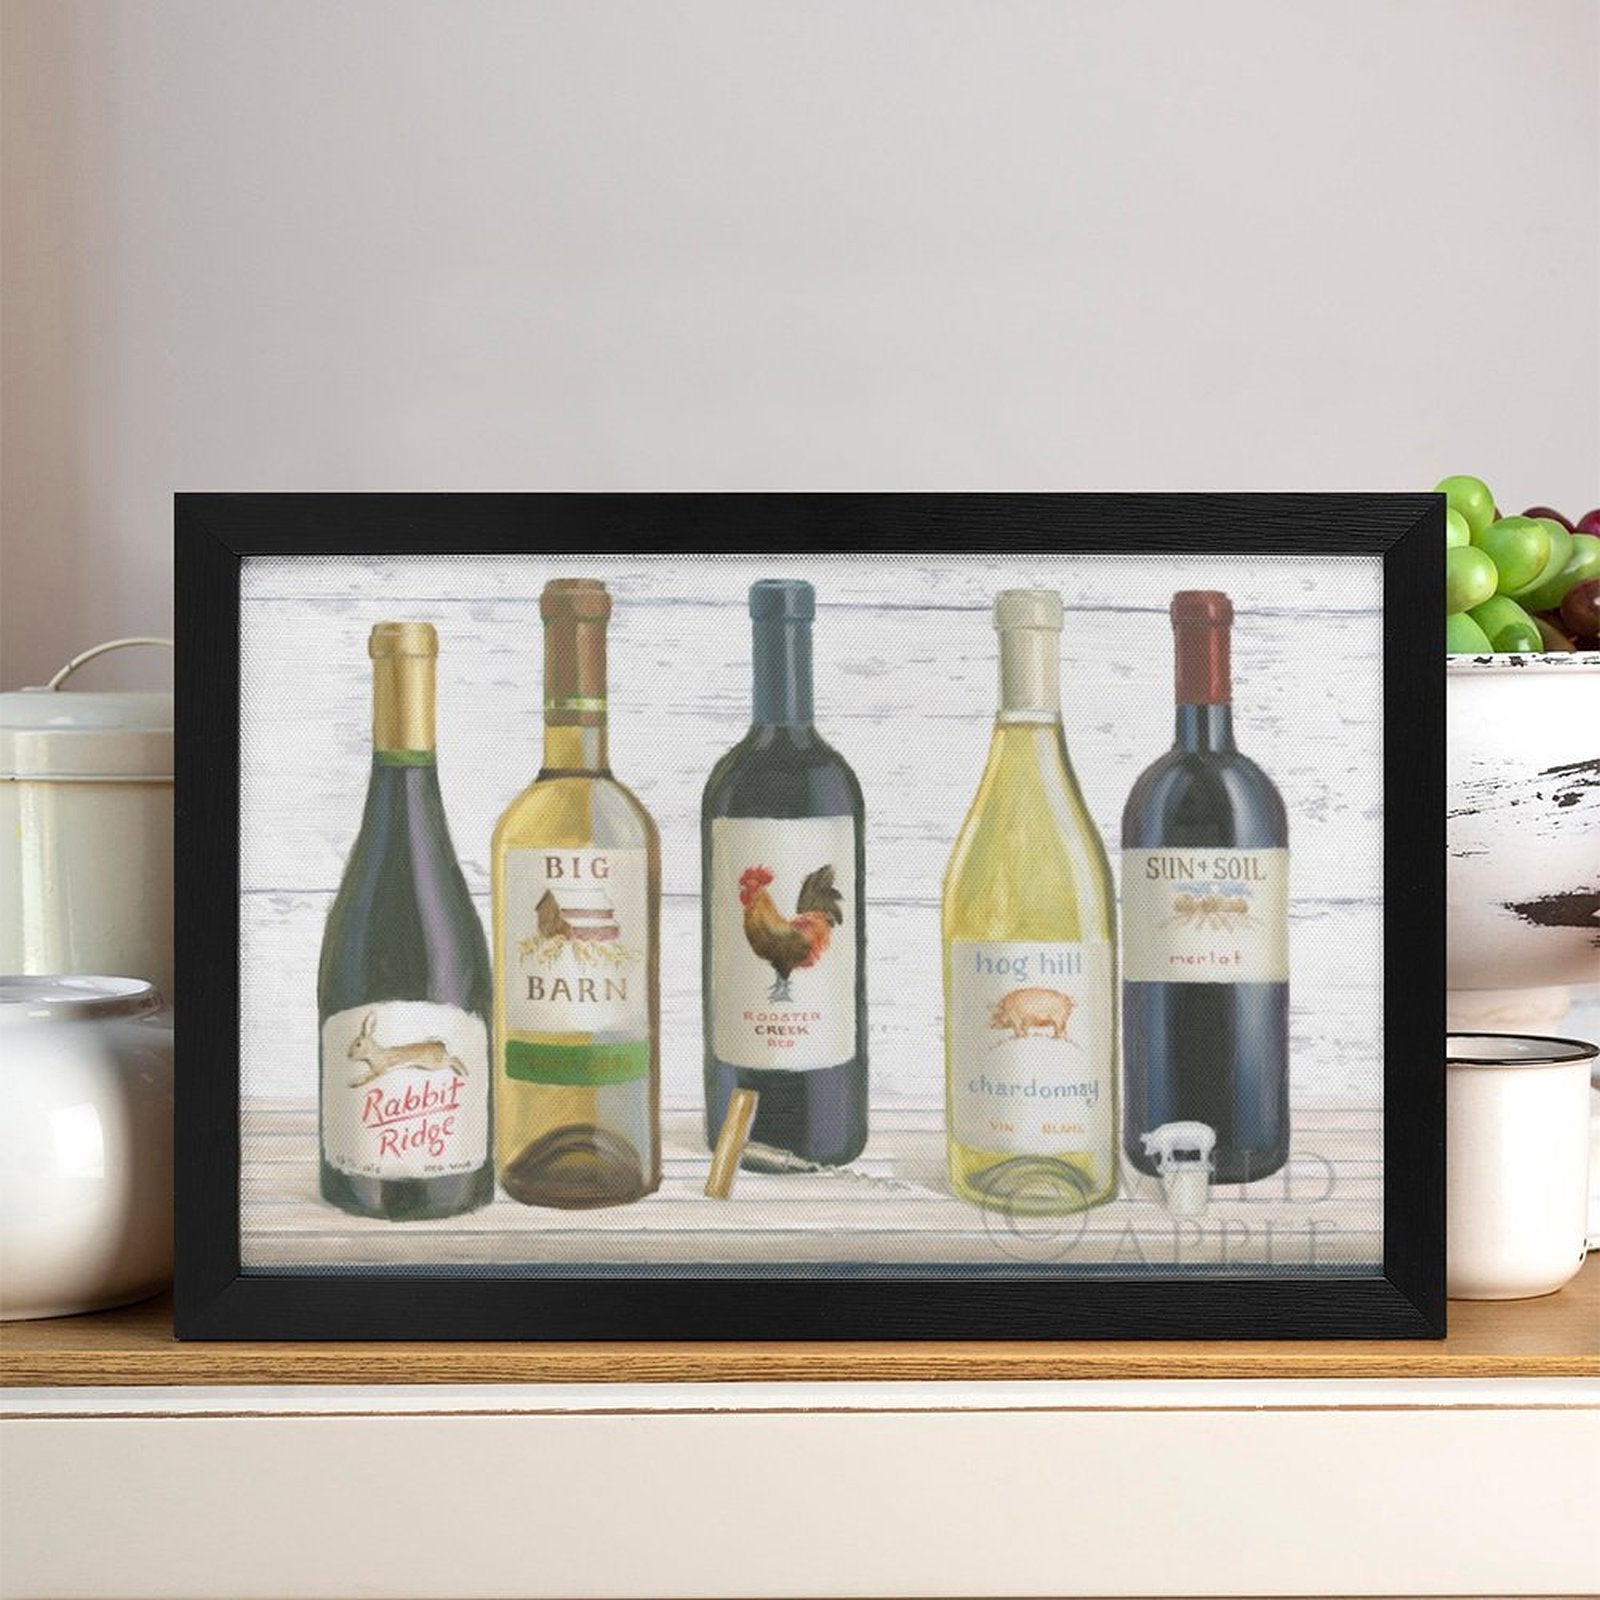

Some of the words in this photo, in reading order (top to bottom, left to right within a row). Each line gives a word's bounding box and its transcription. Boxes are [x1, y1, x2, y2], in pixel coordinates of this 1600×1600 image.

[545, 856, 612, 879] BIG
[1146, 857, 1194, 880] SUN
[1213, 857, 1267, 881] SOIL
[974, 951, 1029, 982] hog
[1038, 952, 1083, 975] hill
[1169, 950, 1243, 966] merlot
[526, 975, 628, 1003] BARN
[743, 1010, 822, 1022] ROOSTER
[754, 1024, 810, 1036] CREEK
[362, 1076, 466, 1123] Rabbit
[967, 1074, 1100, 1109] chardonnay
[379, 1116, 456, 1158] Ridge
